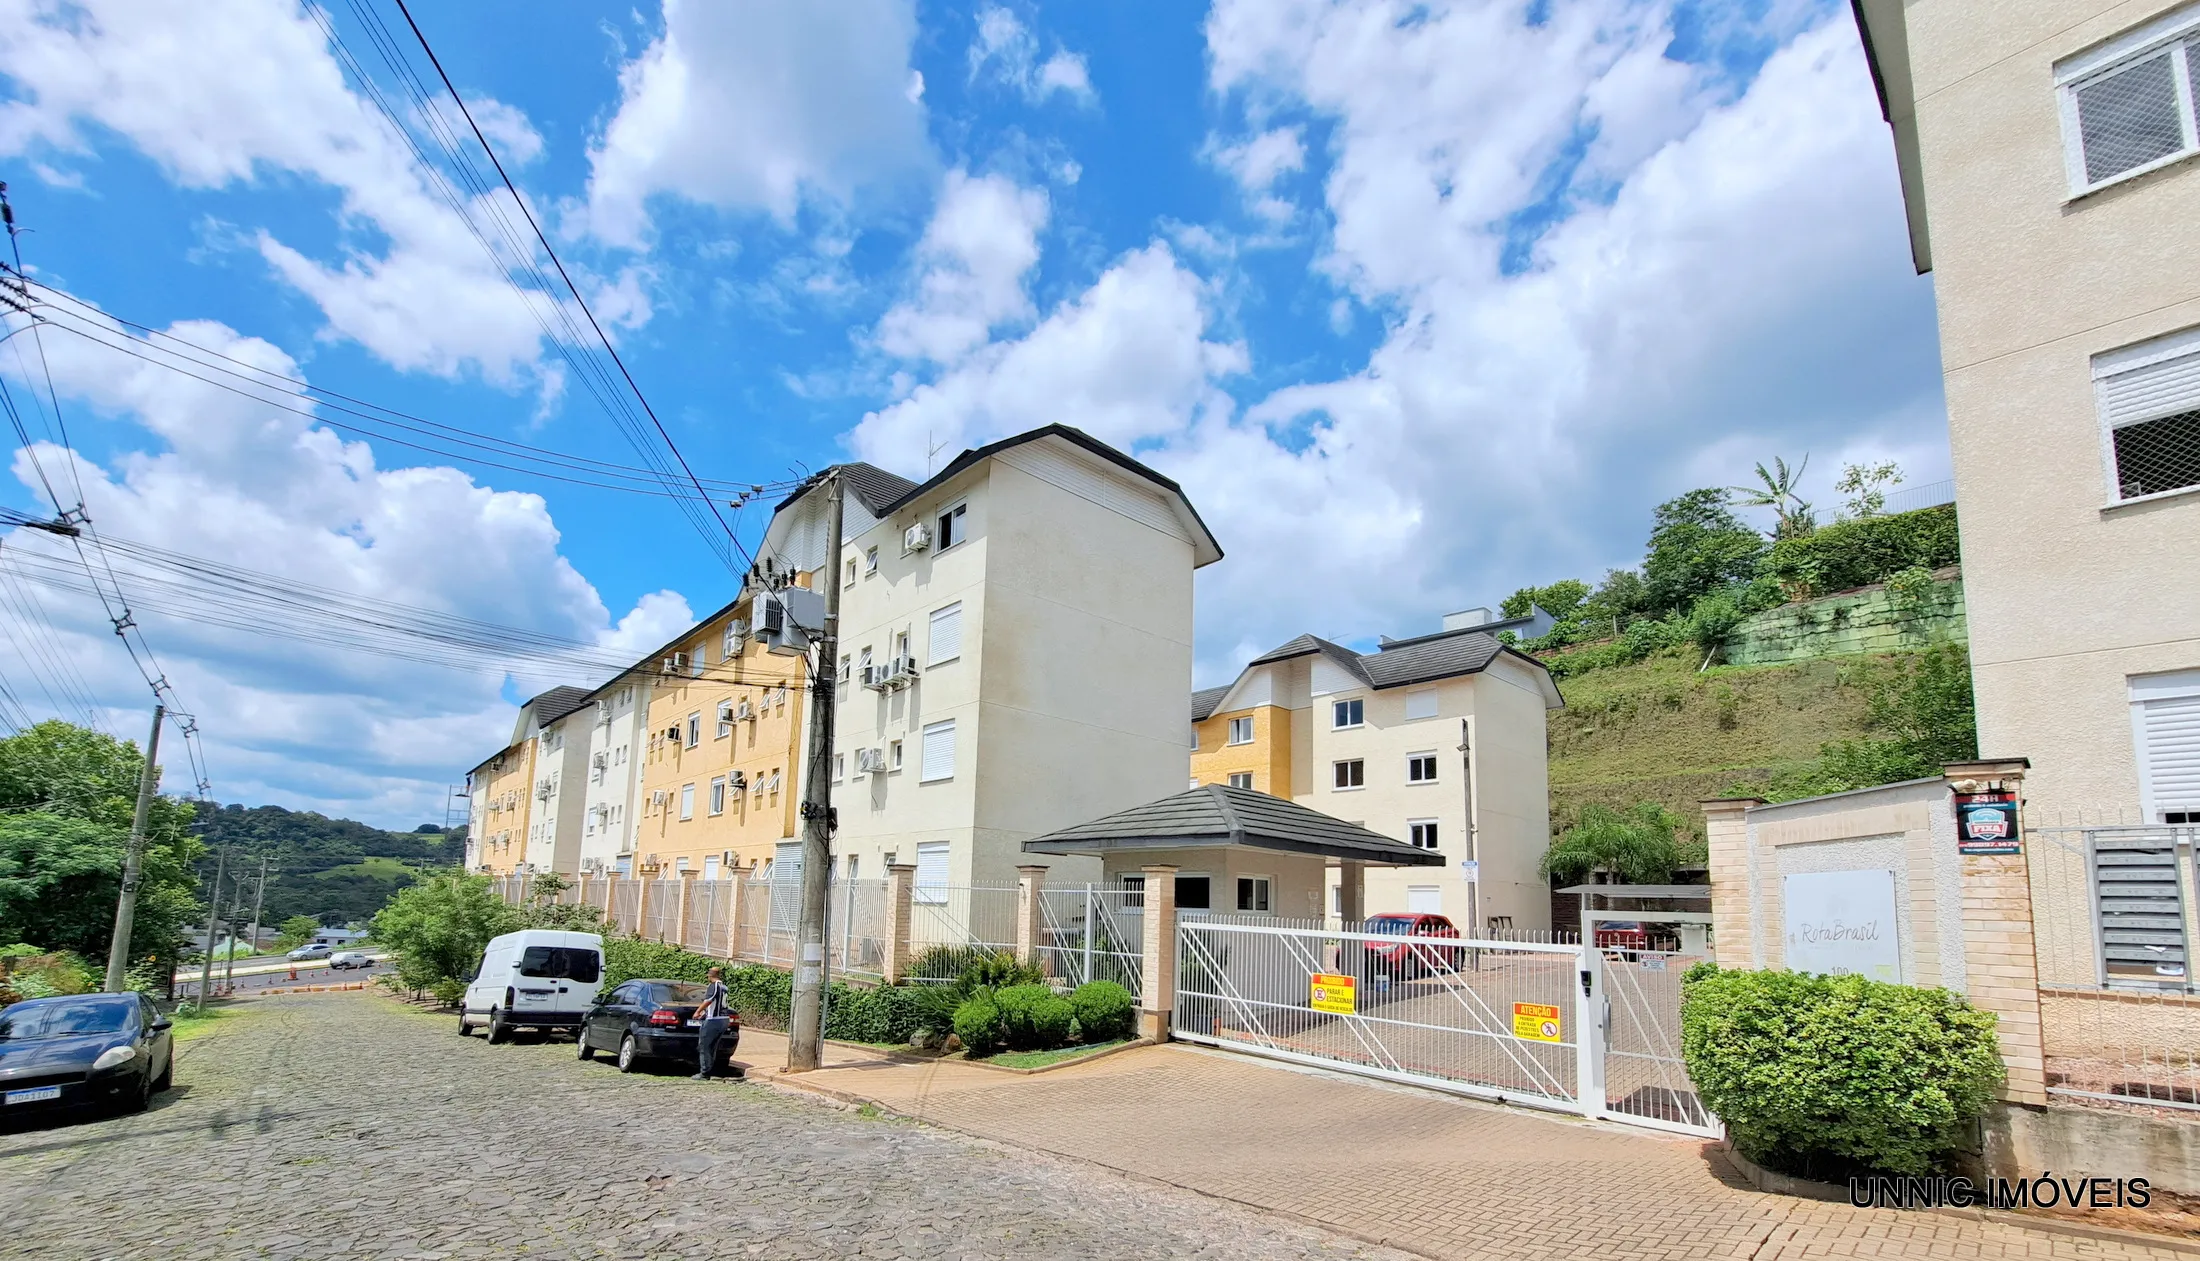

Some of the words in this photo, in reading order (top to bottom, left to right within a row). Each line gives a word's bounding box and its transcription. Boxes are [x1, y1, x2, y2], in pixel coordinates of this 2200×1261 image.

[1974, 825, 2002, 833] FIXA
[1801, 919, 1879, 943] RotaBrasil
[1326, 988, 1341, 996] PARAR
[1326, 996, 1352, 1004] ESTACIONAR
[1520, 1005, 1551, 1017] ATENÇÃO
